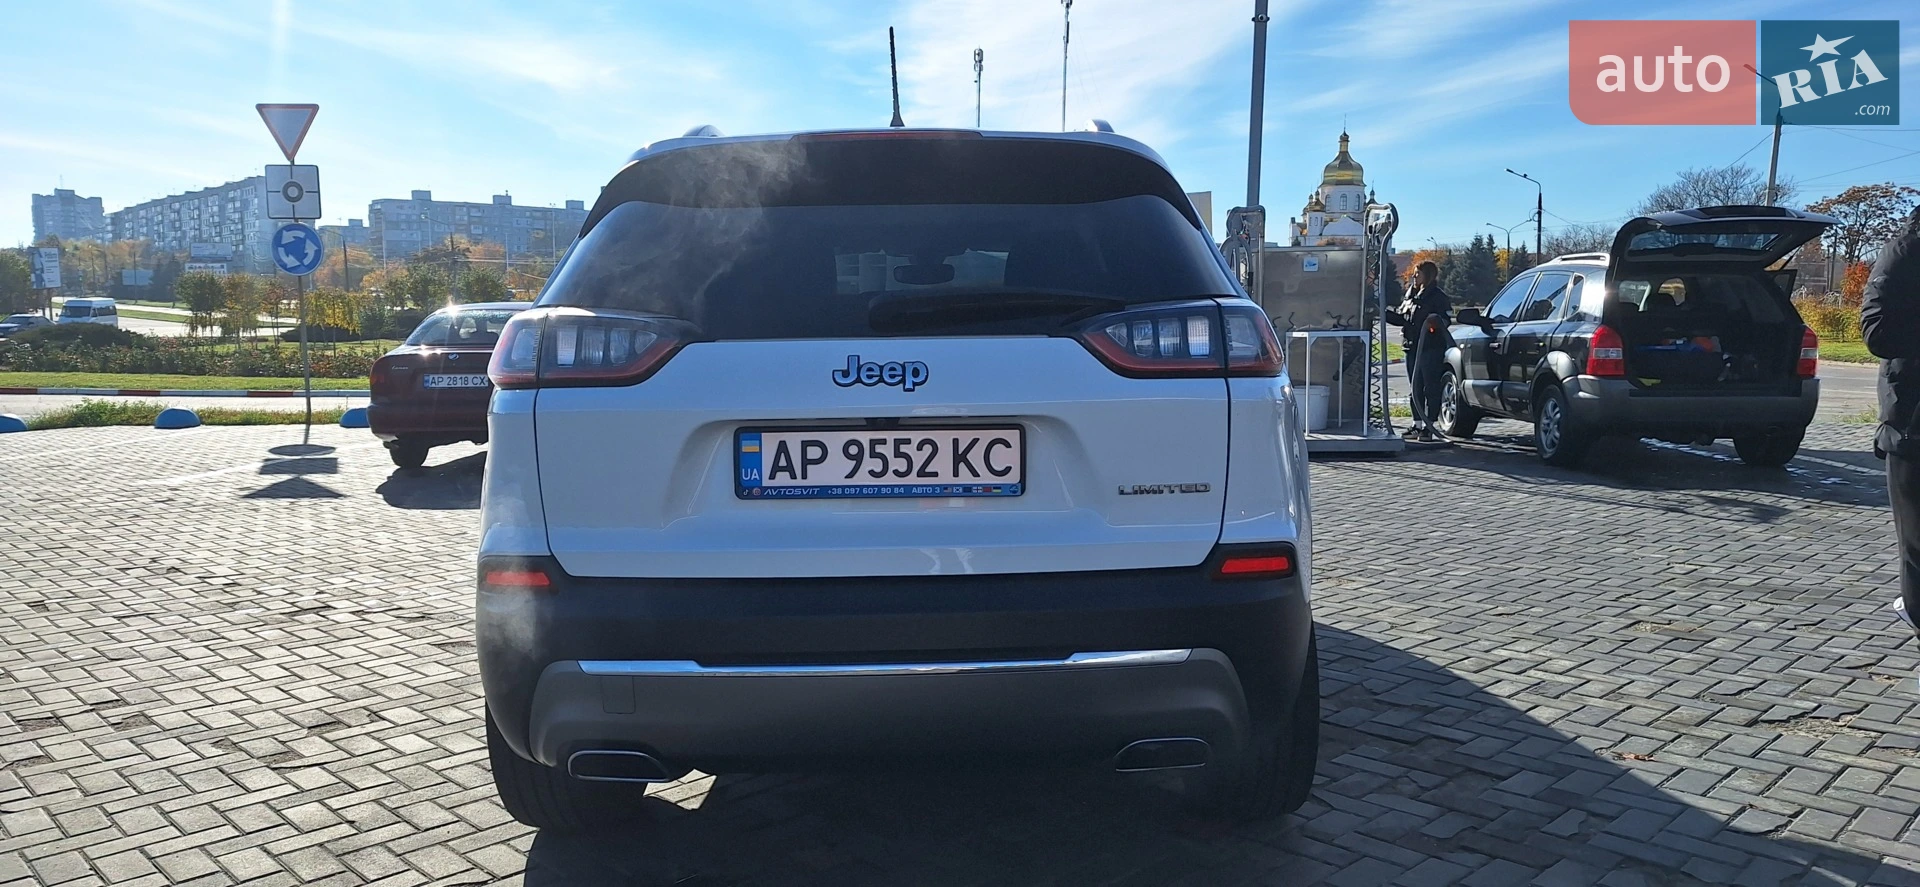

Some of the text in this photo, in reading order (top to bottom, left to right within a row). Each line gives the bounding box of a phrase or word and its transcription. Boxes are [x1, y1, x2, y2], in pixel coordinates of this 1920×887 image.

[832, 355, 929, 392] Jeep
[430, 376, 486, 386] AP 2818 CX
[768, 437, 1012, 480] AP 9552 KC
[742, 468, 760, 480] UA
[763, 487, 820, 496] AVTOSVIT
[862, 487, 878, 495] 607
[880, 487, 892, 495] 90
[893, 487, 905, 495] 84
[1118, 483, 1211, 495] LIMITED
